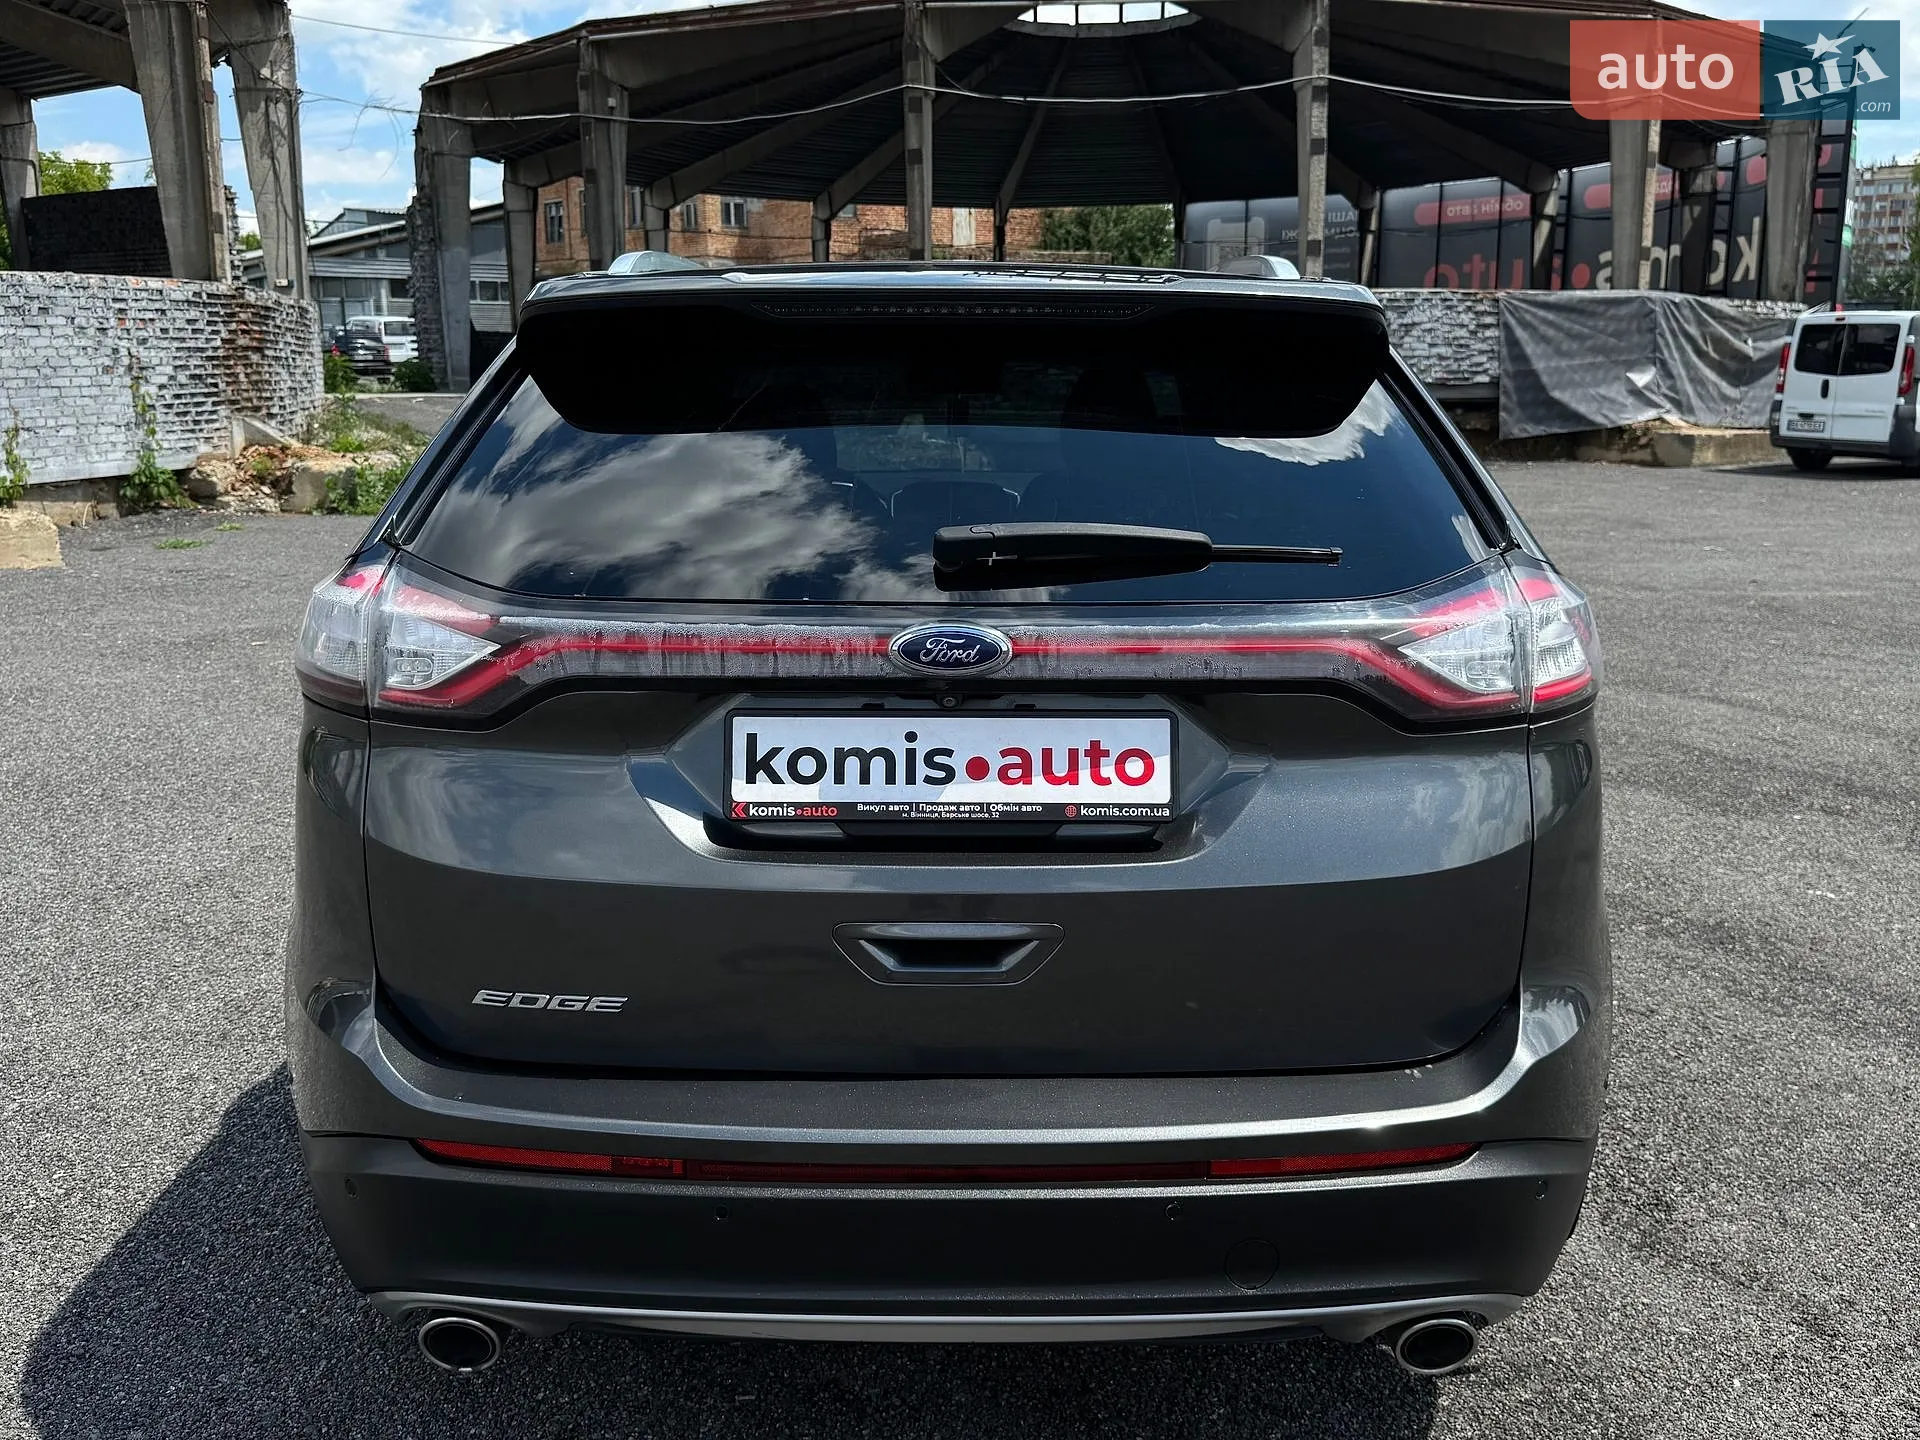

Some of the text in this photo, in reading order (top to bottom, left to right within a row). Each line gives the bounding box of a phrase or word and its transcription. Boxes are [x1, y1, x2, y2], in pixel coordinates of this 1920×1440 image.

[920, 637, 981, 663] Ford
[857, 803, 886, 812] Викуп
[919, 803, 957, 812] Продаж
[959, 804, 981, 812] авто
[989, 803, 1019, 812] Обмін
[1080, 805, 1170, 817] komis.com.ua
[472, 989, 629, 1013] EDGE
